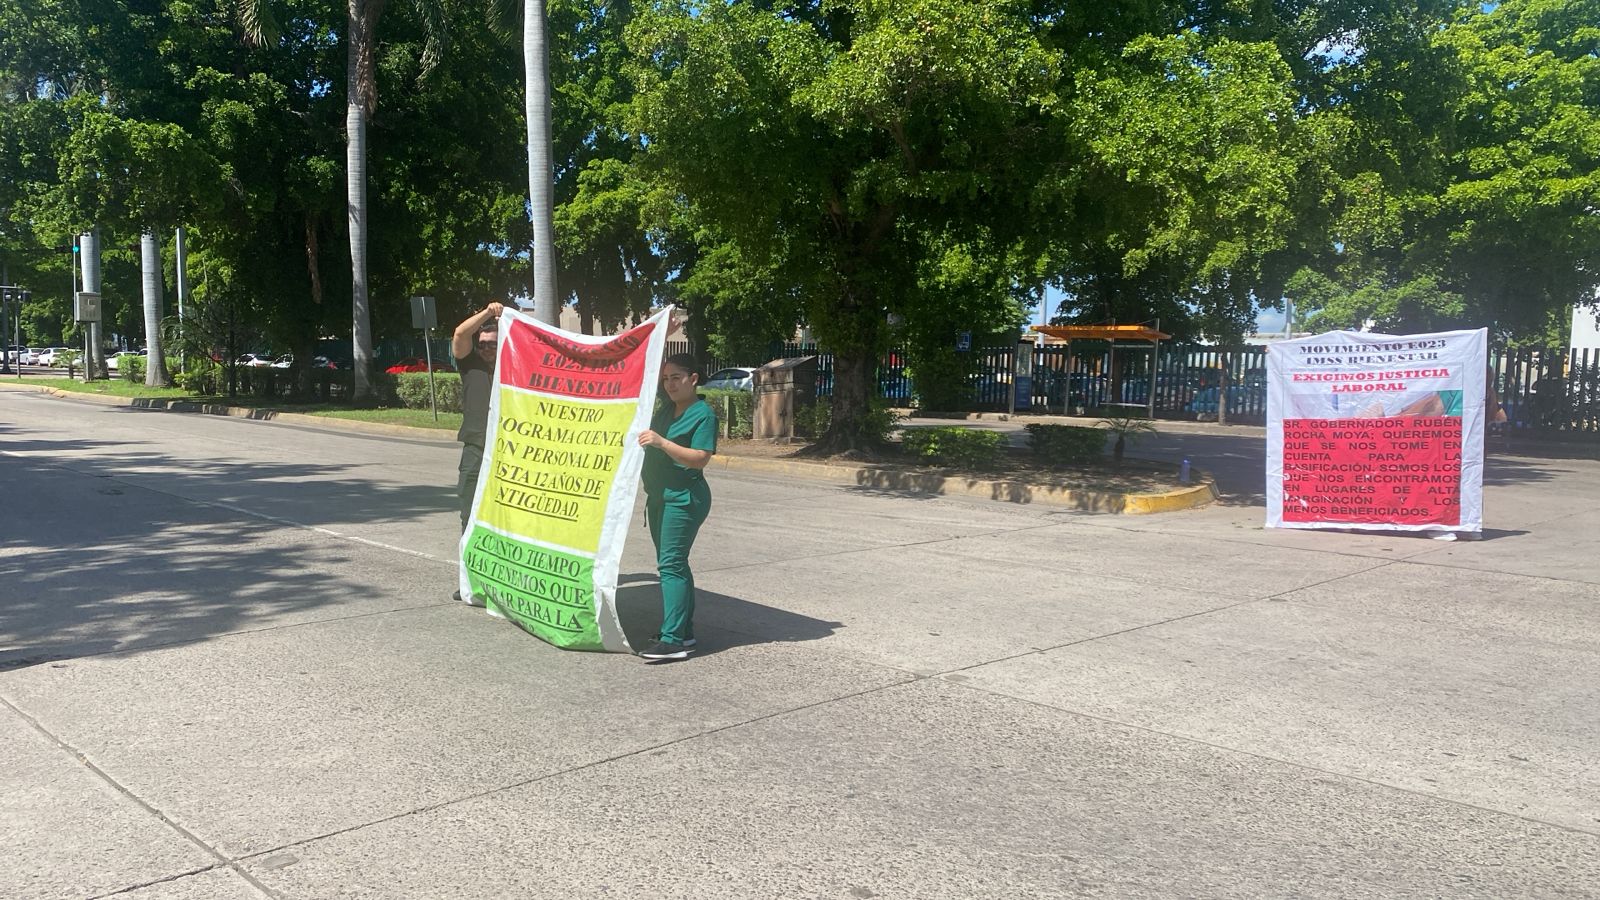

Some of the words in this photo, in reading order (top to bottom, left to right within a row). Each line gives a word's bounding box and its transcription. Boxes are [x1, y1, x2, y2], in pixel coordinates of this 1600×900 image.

[1306, 355, 1342, 365] IMSS
[1292, 371, 1375, 382] EXIGIMOS
[1378, 368, 1450, 382] JUSTICIA
[528, 372, 622, 396] BIENESTAR
[1331, 383, 1407, 393] LABORAL
[536, 401, 605, 423] NUESTRO
[1284, 420, 1303, 429] SR.
[1310, 420, 1404, 429] GOBERNADOR
[1413, 417, 1462, 428] RUBÉN
[499, 416, 575, 446] OGRAMA
[576, 430, 625, 448] CUENTA
[1284, 431, 1326, 440] ROCHA
[1383, 430, 1462, 440] QUEREMOS
[1284, 442, 1310, 451] QUE
[1321, 442, 1336, 450] SE
[1349, 442, 1377, 450] NOS
[1391, 441, 1430, 450] TOME
[1443, 441, 1461, 450] EN
[496, 437, 520, 456] ON
[522, 445, 590, 469] PERSONAL
[592, 454, 614, 472] DE
[1284, 452, 1331, 461] CUENTA
[1369, 453, 1405, 461] PARA
[1444, 452, 1462, 461] LA
[1284, 463, 1375, 472] BASIFICACIÓN.
[1380, 464, 1429, 472] SOMOS
[1434, 464, 1462, 473] LOS
[533, 472, 549, 488] 12
[549, 472, 582, 494] AÑOS
[584, 479, 605, 496] DE
[1319, 474, 1344, 483] NOS
[1355, 475, 1462, 483] ENCONTRAMOS
[1284, 484, 1300, 492] EN
[1315, 485, 1376, 494] LUGARES
[1393, 486, 1411, 494] DE
[1428, 486, 1461, 494] ALTA
[495, 486, 580, 518] NTIGÜEDAD.
[1434, 497, 1461, 506] LOS
[1284, 505, 1327, 515] MENOS
[1331, 506, 1433, 516] BENEFICIADOS.
[526, 549, 581, 578] TIEMPO
[466, 551, 488, 572] MAS
[491, 561, 547, 595] TENEMOS
[550, 582, 587, 606] QUE
[516, 598, 552, 624] PARA
[556, 609, 584, 629] LA
